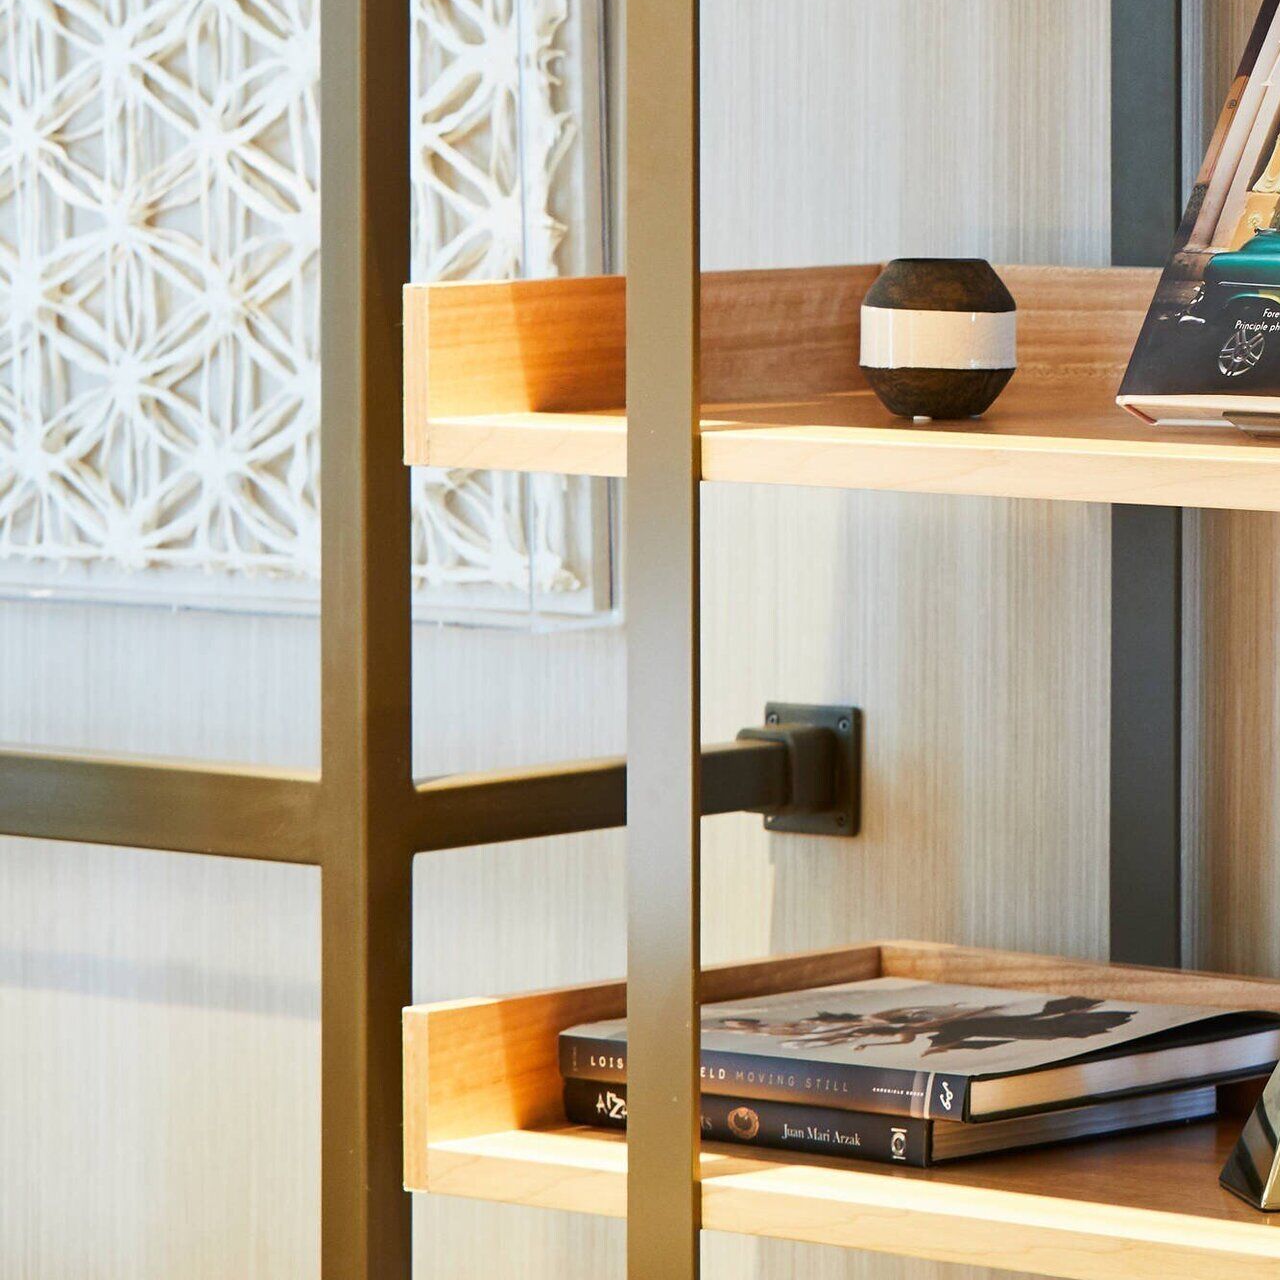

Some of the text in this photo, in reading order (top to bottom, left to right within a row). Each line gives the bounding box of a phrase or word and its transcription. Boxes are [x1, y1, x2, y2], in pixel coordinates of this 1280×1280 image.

[1234, 320, 1268, 332] Principle
[590, 1055, 624, 1070] LOIS
[735, 1070, 796, 1087] MOVING
[804, 1077, 849, 1093] STILL
[781, 1123, 805, 1140] Juan
[807, 1126, 830, 1142] Mari
[832, 1131, 861, 1147] Arzak
